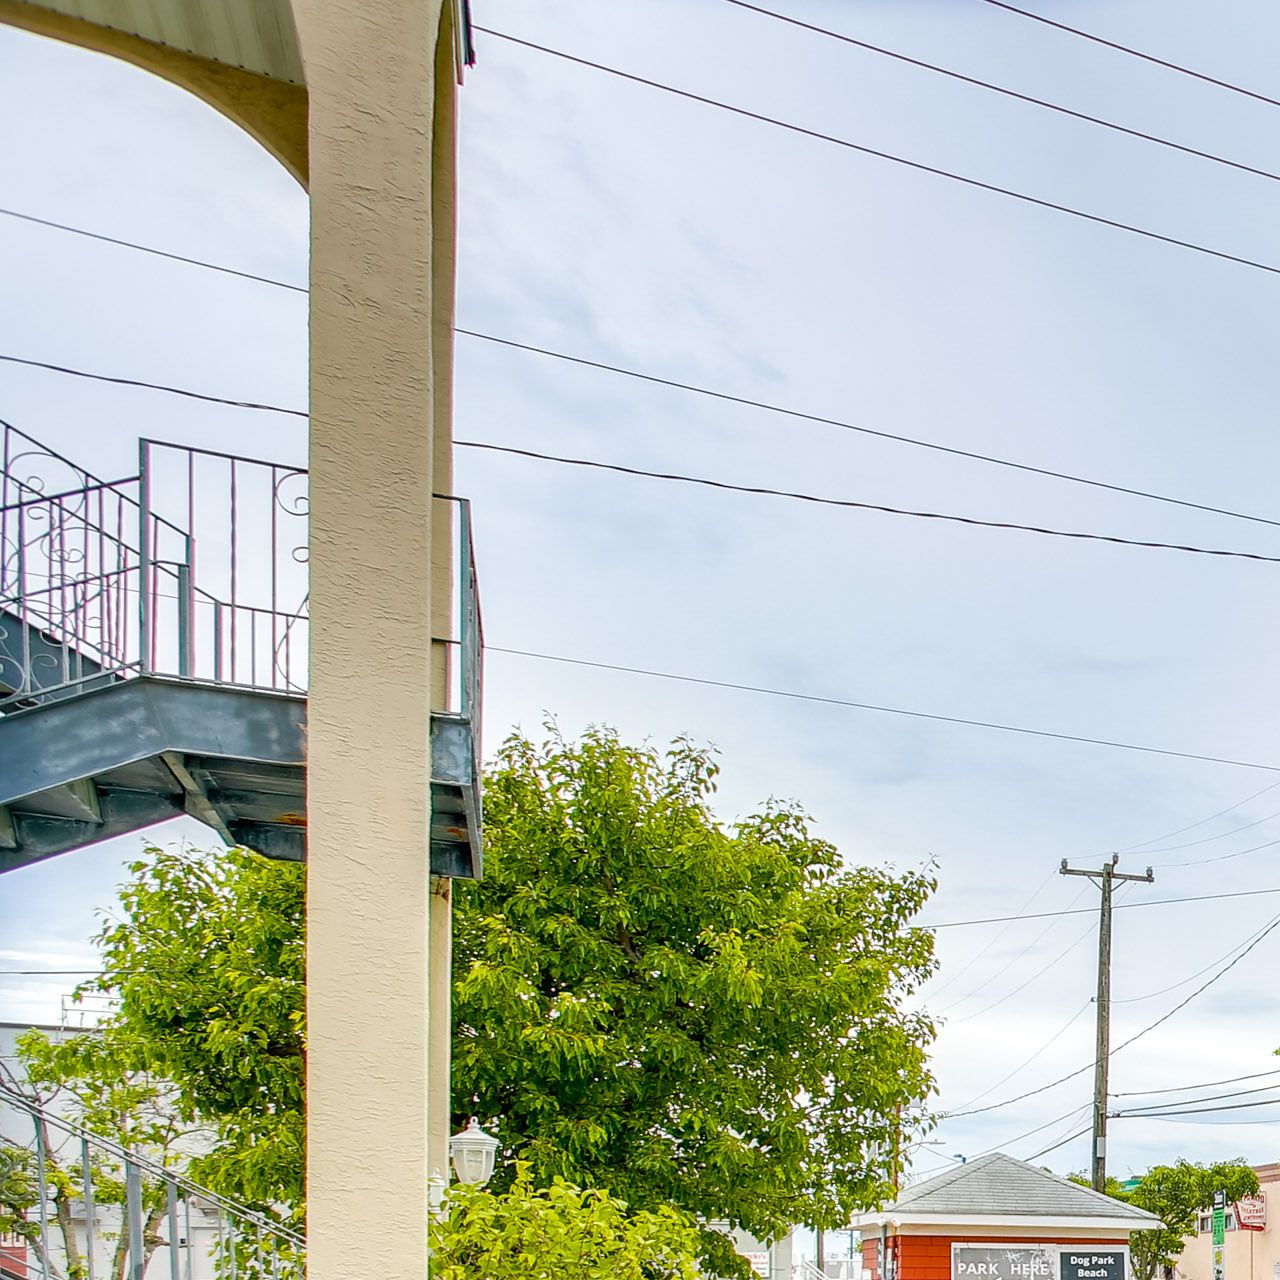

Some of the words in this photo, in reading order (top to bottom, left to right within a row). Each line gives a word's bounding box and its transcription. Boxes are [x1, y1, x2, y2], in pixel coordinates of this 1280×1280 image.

[1070, 1255, 1090, 1267] Dog
[1091, 1255, 1115, 1265] Park
[958, 1262, 999, 1275] PARK
[1010, 1263, 1049, 1276] HERE
[1077, 1268, 1108, 1278] Beach
